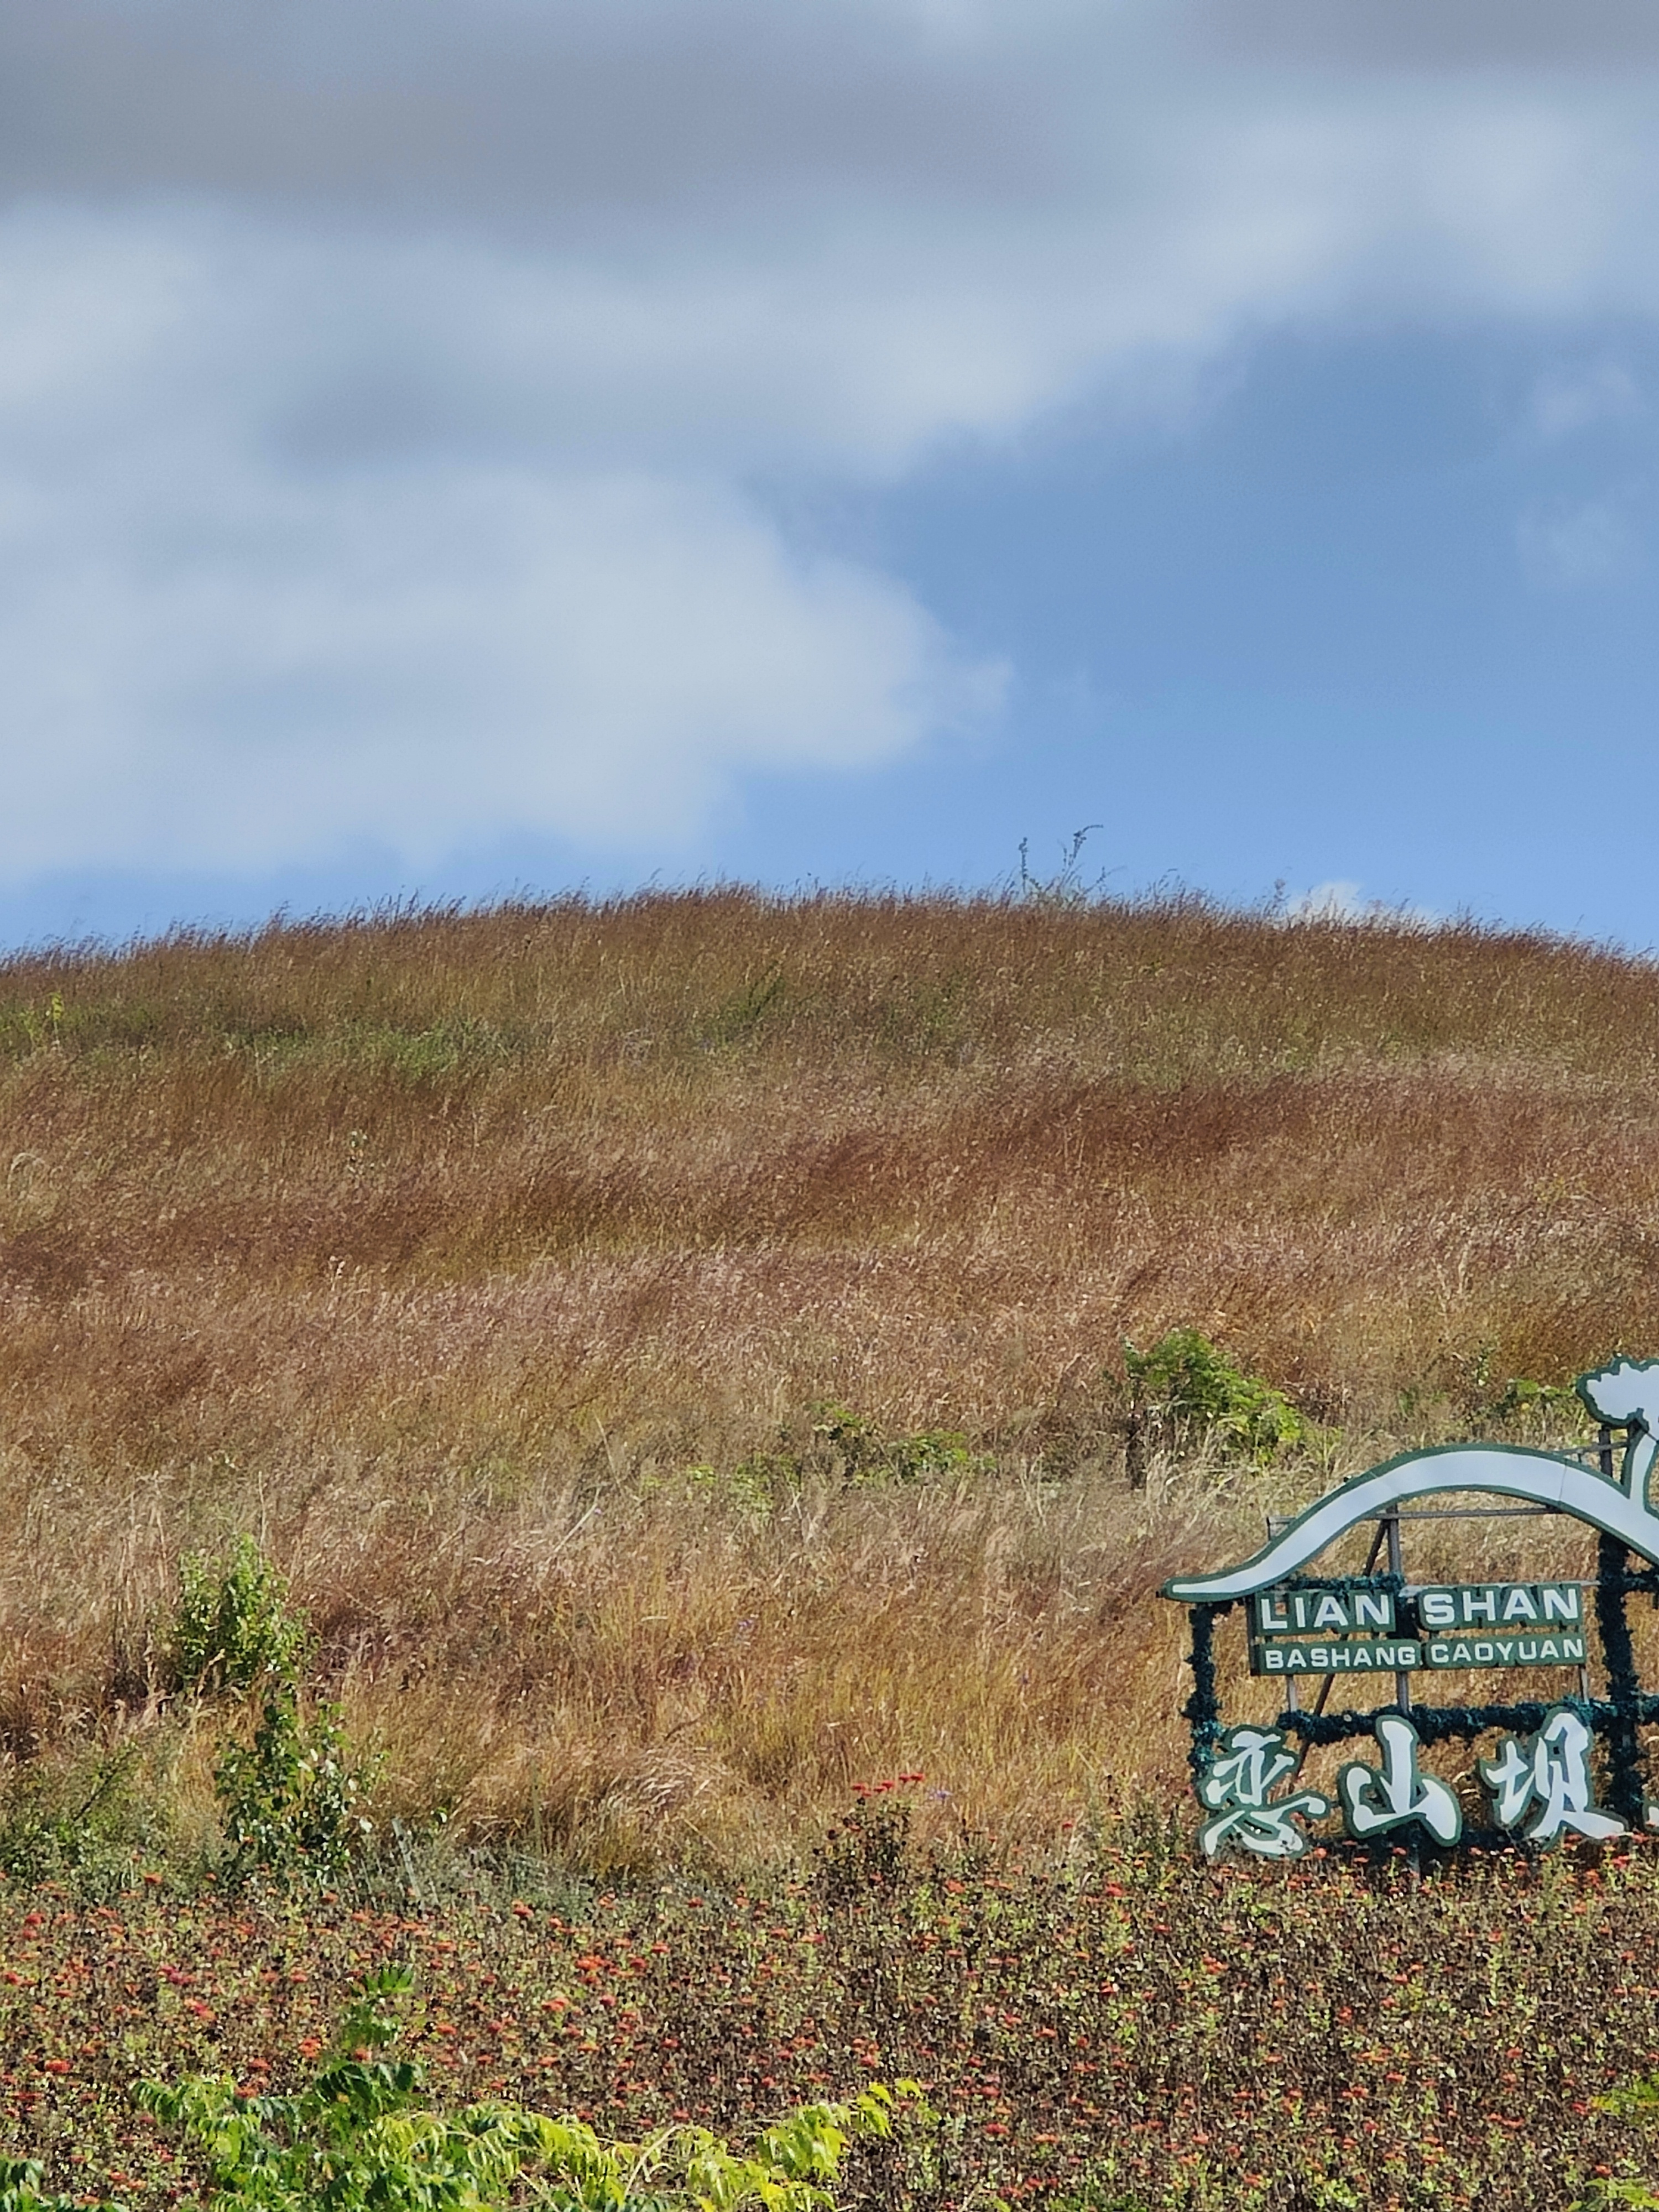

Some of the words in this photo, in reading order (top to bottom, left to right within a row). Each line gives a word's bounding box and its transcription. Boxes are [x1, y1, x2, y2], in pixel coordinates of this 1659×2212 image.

[1260, 1594, 1390, 1630] LIAN
[1423, 1588, 1578, 1625] SHAN
[1265, 1646, 1416, 1669] BASHANG
[1430, 1638, 1584, 1663] CAOYUAN
[1204, 1712, 1659, 1855] 恋山坝
